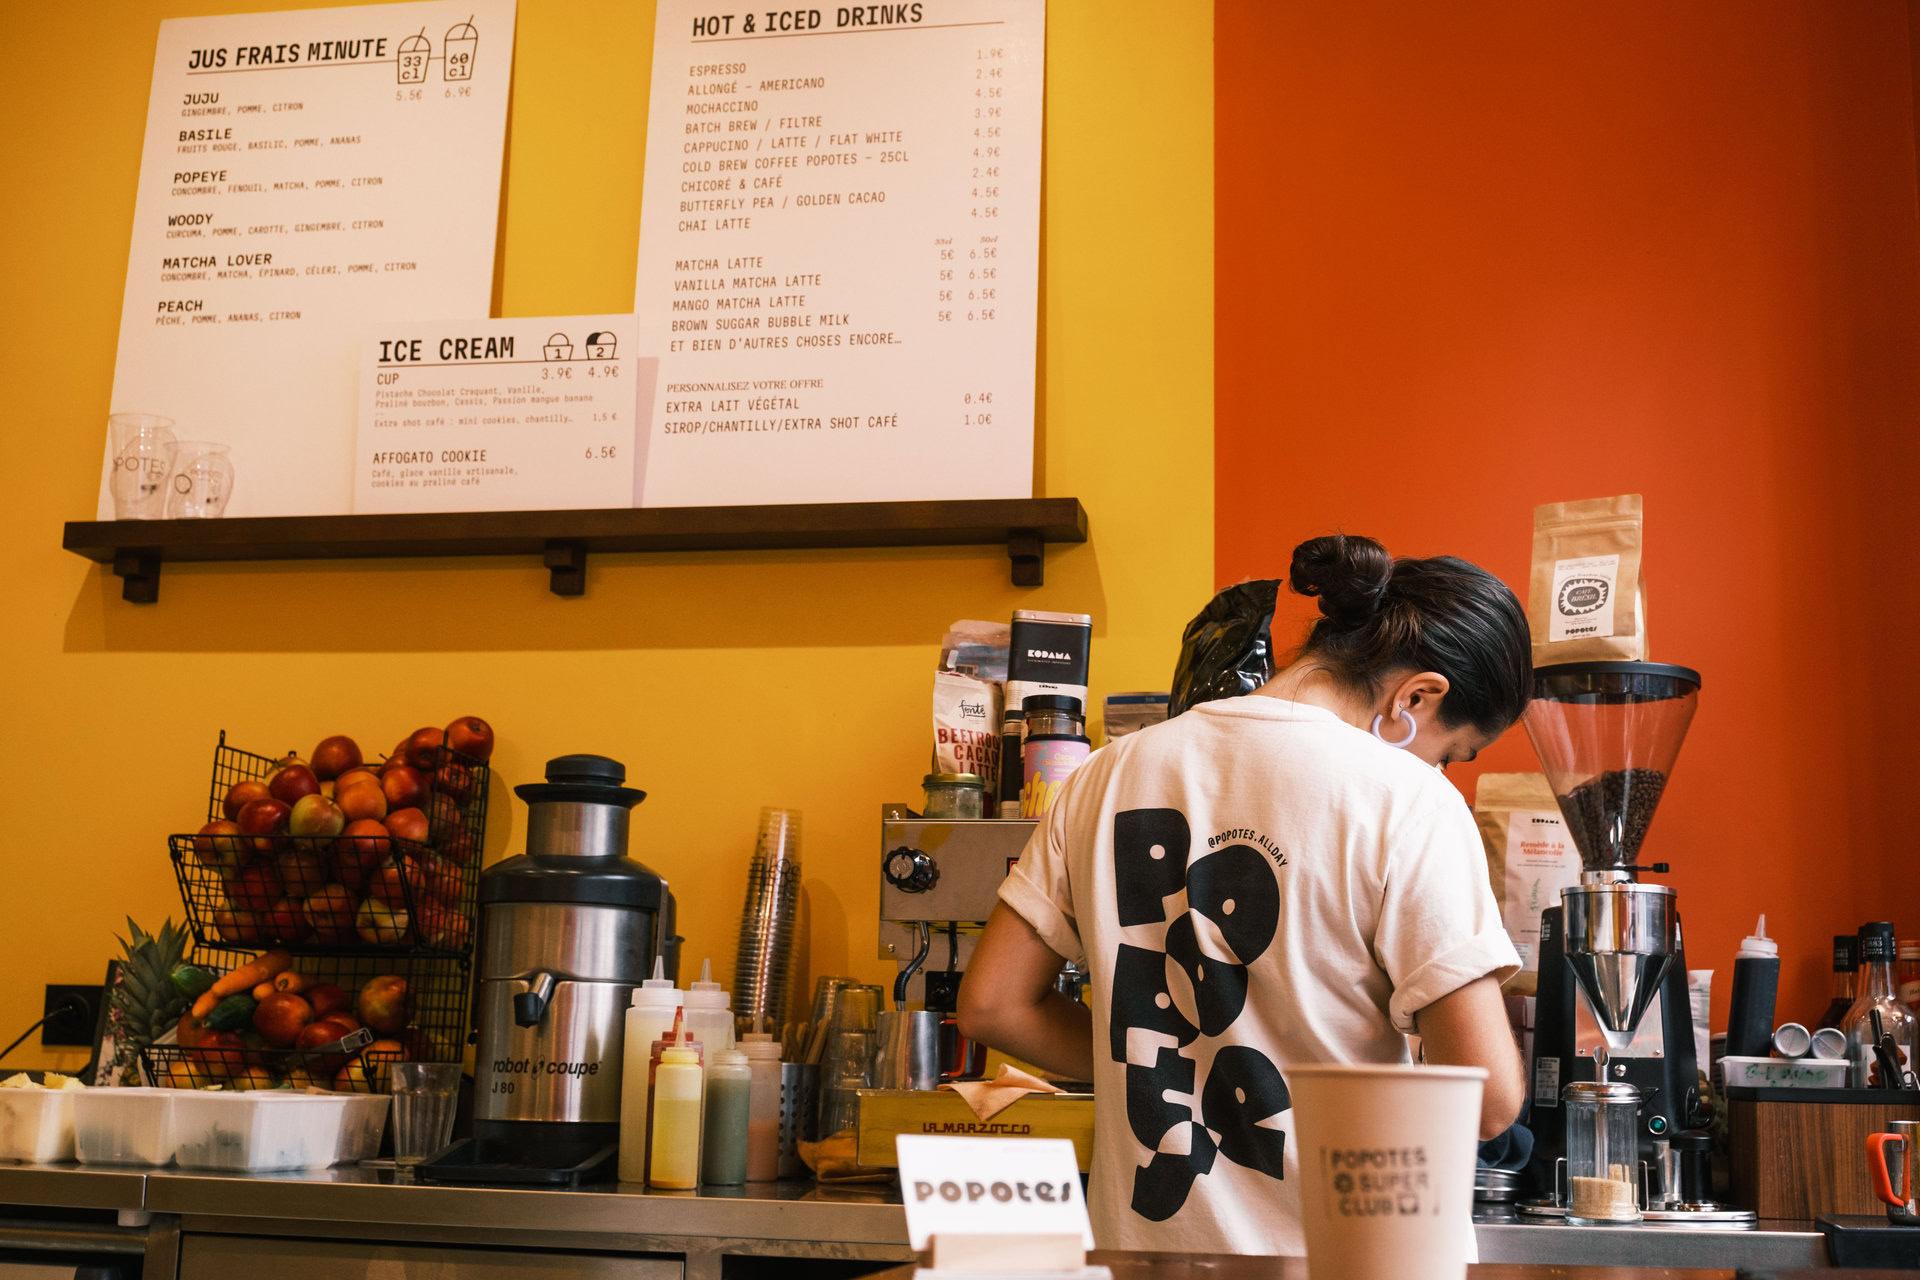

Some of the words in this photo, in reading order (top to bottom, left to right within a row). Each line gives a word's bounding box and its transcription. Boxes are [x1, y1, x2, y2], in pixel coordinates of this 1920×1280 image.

[692, 15, 735, 36] HOT
[743, 15, 756, 33] &
[764, 10, 821, 32] ICED
[836, 3, 923, 28] DRINKS
[188, 49, 227, 69] JUS
[235, 43, 300, 66] FRAIS
[307, 38, 388, 61] MINUTE
[403, 55, 422, 68] 33
[450, 52, 470, 65] 60
[977, 48, 1003, 60] 1.9€
[690, 63, 746, 76] ESPRESSO
[976, 68, 1002, 79] 2.4€
[445, 86, 471, 98] 6.9€
[688, 80, 737, 95] ALLONGÉ
[760, 77, 824, 91] AMERICANO
[184, 93, 219, 105] JUJU
[396, 89, 422, 101] 5.5€
[975, 88, 1002, 98] 4.5€
[182, 107, 230, 117] GINGEMBRE,
[237, 104, 267, 114] POMME,
[273, 103, 303, 111] CITRON
[686, 100, 758, 114] MOCHACCINO
[974, 107, 1001, 118] 3.9€
[686, 122, 720, 134] BATCH
[729, 120, 757, 131] BREW
[780, 116, 822, 128] FILTRE
[179, 128, 232, 141] BASILE
[974, 127, 1000, 138] 4.5€
[177, 144, 207, 153] FRUITS
[212, 143, 241, 152] ROUGE,
[248, 140, 287, 150] BASILIC,
[294, 139, 323, 147] POMME,
[330, 136, 360, 144] ANANAS
[684, 140, 748, 153] CAPPUCINO
[772, 136, 806, 149] LATTE
[830, 133, 858, 145] FLAT
[866, 131, 902, 143] WHITE
[973, 147, 1000, 157] 4.9€
[683, 161, 711, 173] COLD
[719, 160, 747, 171] BREW
[755, 156, 797, 169] COFFEE
[807, 153, 857, 166] POPOTES
[881, 151, 908, 163] 25CL
[174, 171, 226, 183] POPEYE
[973, 167, 999, 178] 2.4€
[172, 186, 220, 196] CONCOMBRE,
[228, 184, 267, 193] FENOUIL,
[274, 182, 308, 190] MATCHA,
[315, 180, 344, 188] POMME,
[351, 177, 383, 186] CITRON
[681, 177, 731, 192] CHICORÉ
[739, 179, 745, 189] &
[754, 175, 782, 189] CAFÉ
[972, 187, 999, 198] 4.5€
[680, 199, 744, 212] BUTTERFLY
[753, 197, 773, 208] PEA
[797, 194, 840, 206] GOLDEN
[849, 192, 885, 204] CACAO
[971, 207, 998, 218] 4.5€
[168, 214, 212, 226] WOODY
[679, 220, 706, 232] CHAI
[716, 218, 750, 230] LATTE
[166, 229, 205, 239] CURCUMA,
[213, 228, 241, 236] POMME,
[248, 225, 288, 235] CAROTTE,
[295, 222, 345, 232] GINGEMBRE,
[352, 220, 384, 229] CITRON
[941, 249, 954, 260] 5€
[970, 247, 997, 259] 6.5€
[163, 256, 216, 268] MATCHA
[228, 254, 272, 266] LOVER
[675, 259, 718, 271] MATCHA
[728, 257, 762, 269] LATTE
[940, 270, 953, 280] 5€
[969, 268, 996, 280] 6.5€
[675, 279, 724, 291] VANILLA
[733, 277, 776, 288] MATCHA
[786, 274, 821, 286] LATTE
[939, 290, 952, 301] 5€
[968, 288, 995, 300] 6.5€
[158, 300, 202, 312] PEACH
[673, 299, 709, 311] MANGO
[717, 297, 760, 309] MATCHA
[770, 295, 805, 307] LATTE
[939, 311, 951, 322] 5€
[968, 309, 995, 320] 6.5€
[672, 320, 707, 332] BROWN
[716, 317, 759, 330] SUGGAR
[768, 315, 811, 328] BUBBLE
[820, 314, 849, 325] MILK
[378, 340, 422, 362] ICE
[439, 336, 514, 360] CREAM
[671, 340, 684, 352] ET
[693, 339, 721, 351] BIEN
[729, 337, 788, 350] D'AUTRES
[797, 335, 840, 347] CHOSES
[850, 333, 901, 345] ENCORE…
[554, 348, 562, 358] 1
[596, 347, 604, 358] 2
[542, 367, 572, 380] 3.9€
[588, 366, 619, 377] 4.9€
[377, 373, 399, 385] CUP
[667, 382, 749, 392] PERSONNALISEZ
[753, 380, 786, 389] VOTRE
[790, 379, 823, 388] OFFRE
[667, 401, 702, 413] EXTRA
[712, 400, 739, 412] LAIT
[748, 396, 799, 410] VÉGÉTAL
[964, 393, 992, 404] 0.4€
[665, 418, 821, 434] SIROP/CHANTILLY/EXTRA
[830, 417, 859, 429] SHOT
[868, 413, 897, 428] CAFÉ
[965, 413, 991, 425] 1.0€
[373, 451, 433, 464] AFFOGATO
[442, 450, 486, 462] COOKIE
[586, 446, 616, 459] 6.5€
[1028, 650, 1071, 660] KODAMA
[1208, 829, 1287, 867] @POPOTES.ALLDAY
[493, 1057, 530, 1073] robot
[547, 1062, 599, 1079] coupe
[500, 1082, 514, 1094] 80
[1331, 1148, 1426, 1168] POPOTES
[1359, 1172, 1428, 1191] SUPER
[1339, 1198, 1394, 1215] CLUB
